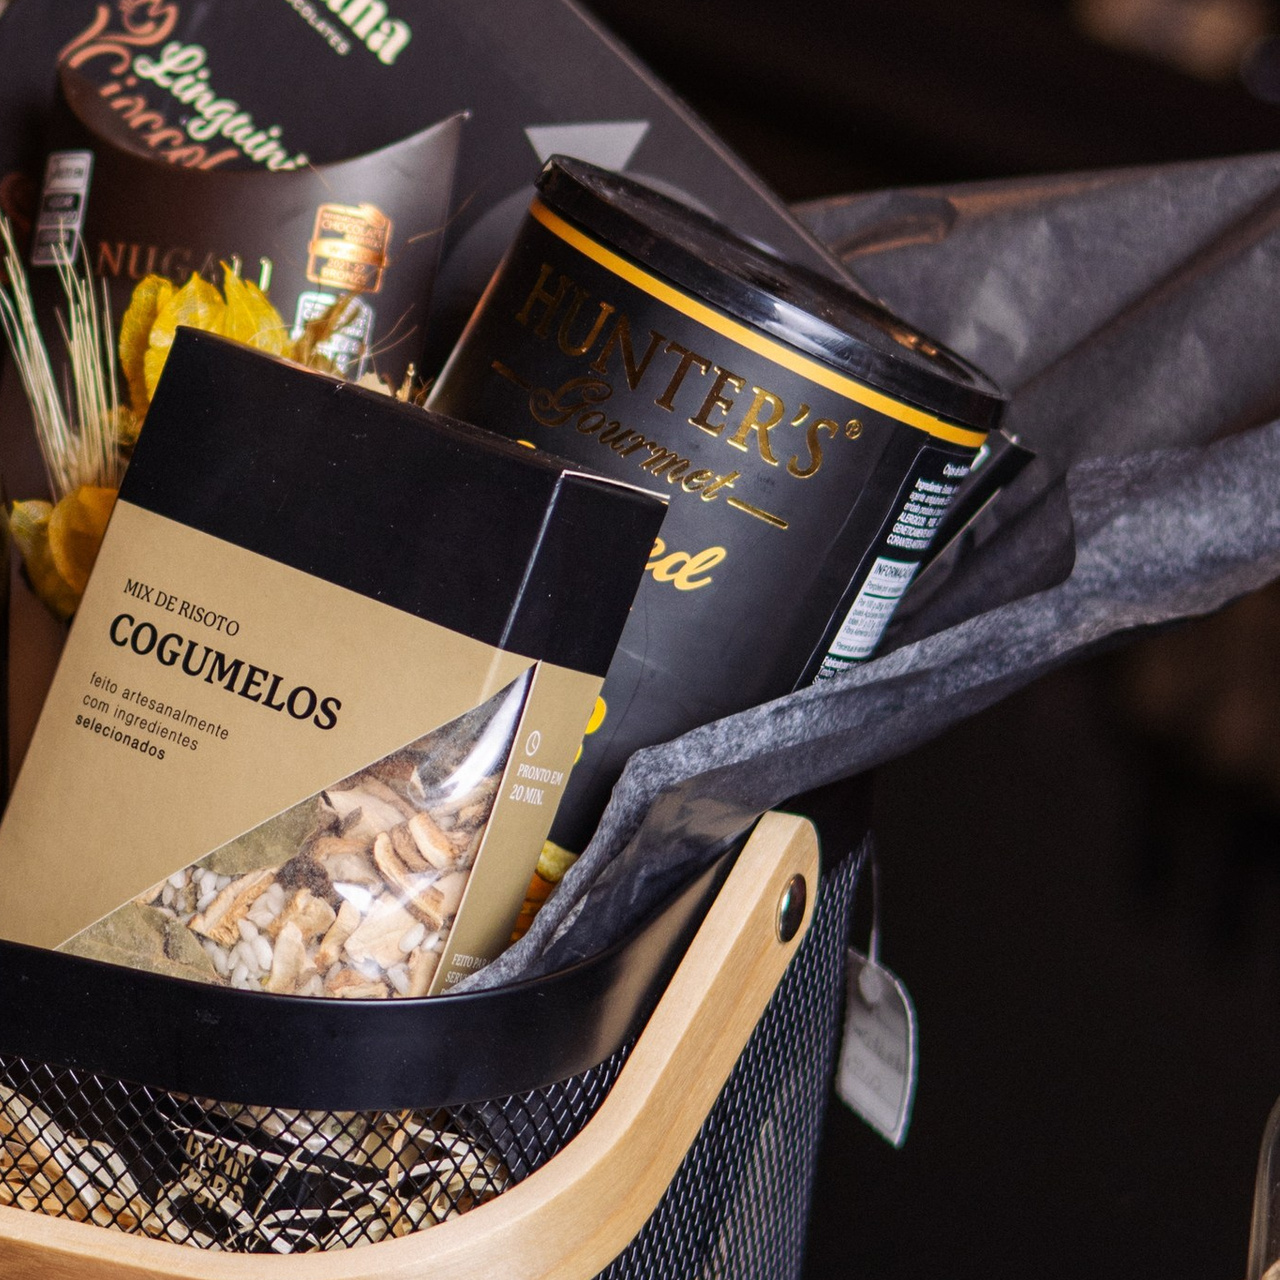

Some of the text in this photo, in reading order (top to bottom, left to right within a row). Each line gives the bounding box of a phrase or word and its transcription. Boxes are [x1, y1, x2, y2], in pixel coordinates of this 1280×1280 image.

[530, 377, 741, 502] Gourmet
[123, 578, 240, 636] MIX DE RISOTO
[109, 614, 342, 730] COGUMELOS
[82, 694, 199, 751] com ingredientes
[89, 672, 229, 741] feito artesanalmente
[75, 713, 166, 760] selecionados
[509, 784, 524, 800] 20
[517, 763, 564, 785] PRONTO EM
